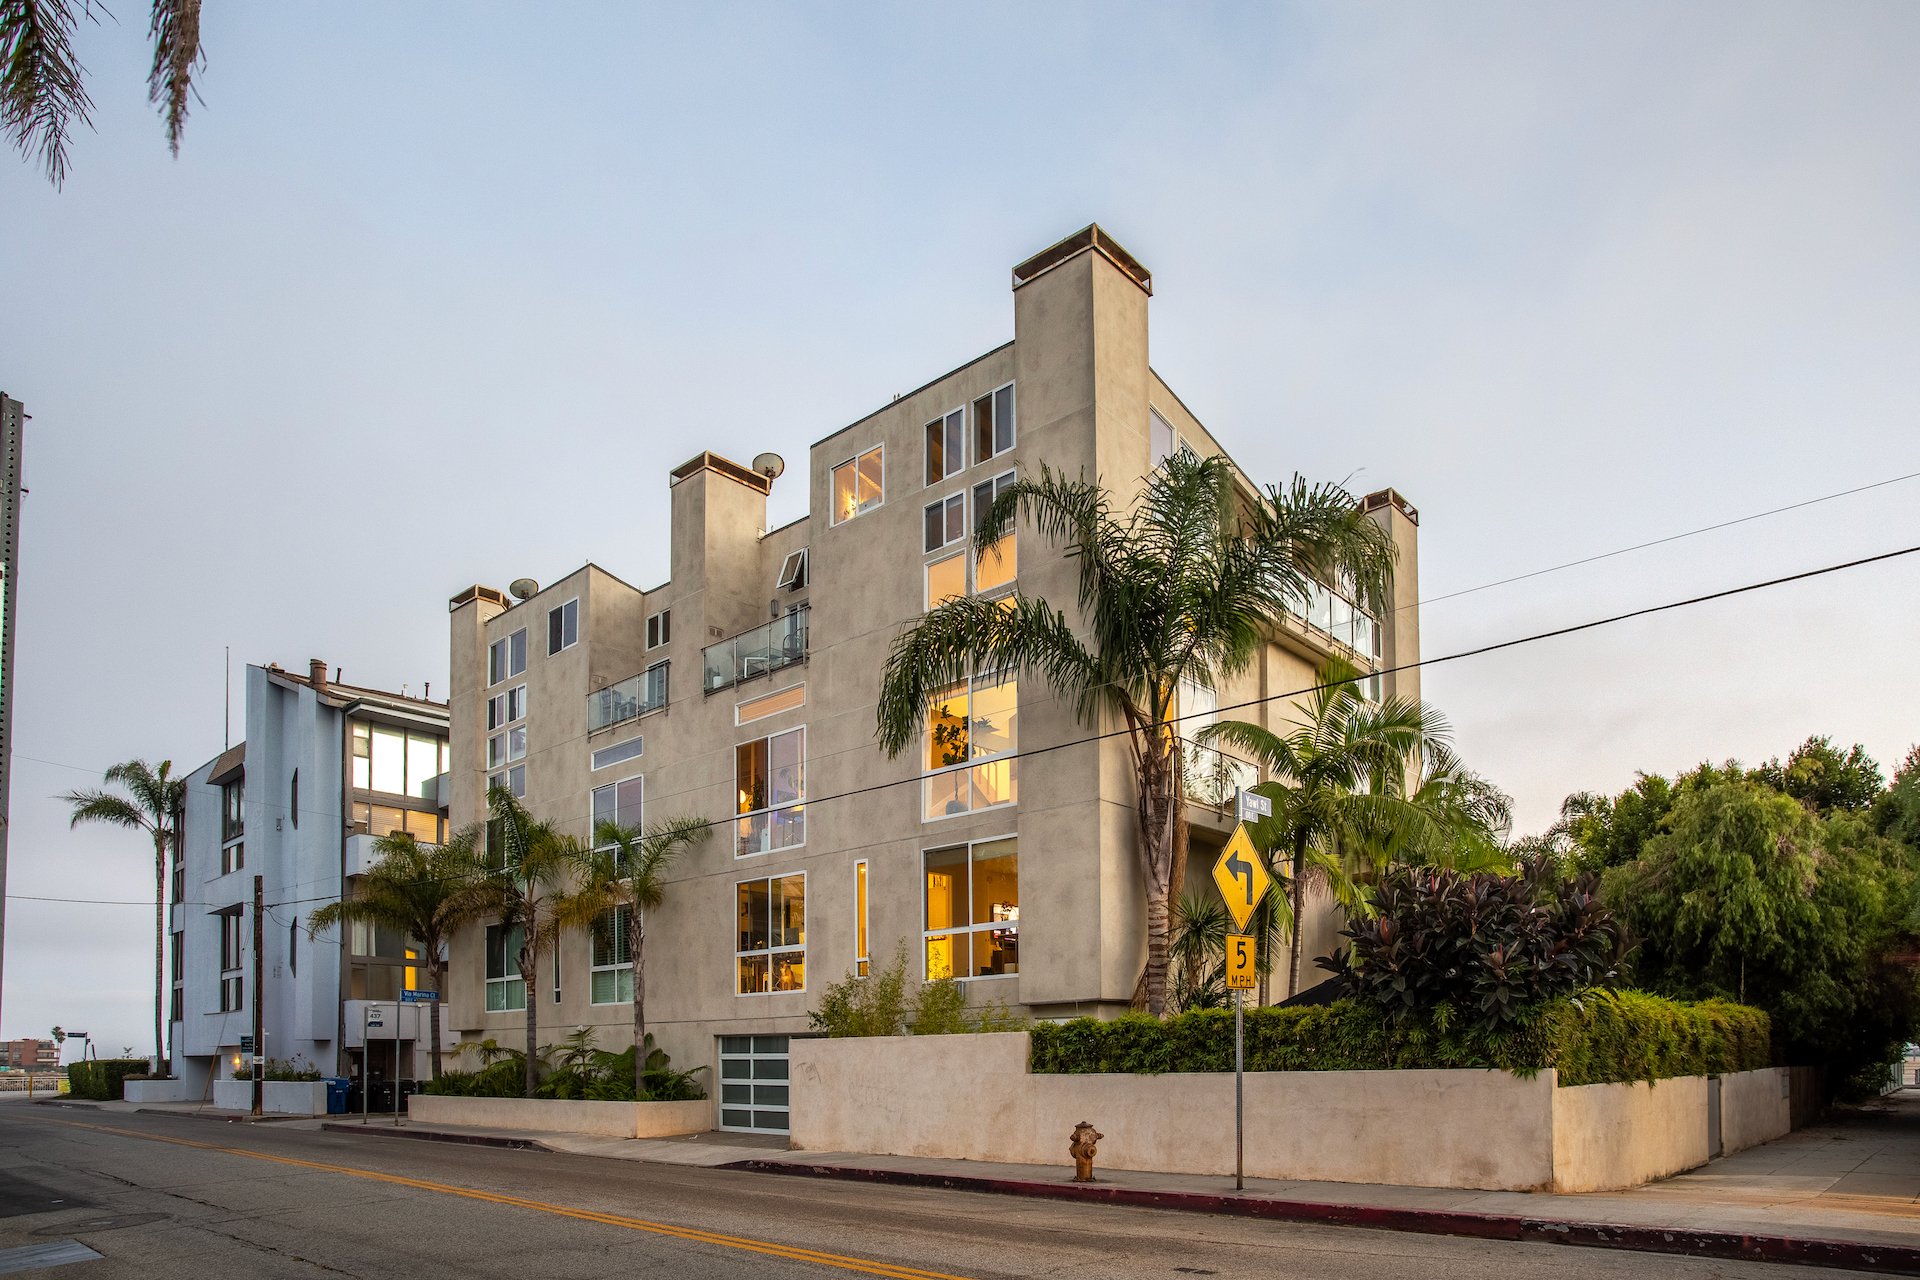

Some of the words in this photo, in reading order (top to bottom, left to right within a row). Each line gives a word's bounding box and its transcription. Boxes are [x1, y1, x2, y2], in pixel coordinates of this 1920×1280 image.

[1245, 795, 1259, 809] Yawl
[1260, 799, 1267, 812] St
[1236, 941, 1247, 969] 5
[1231, 974, 1252, 986] MPH
